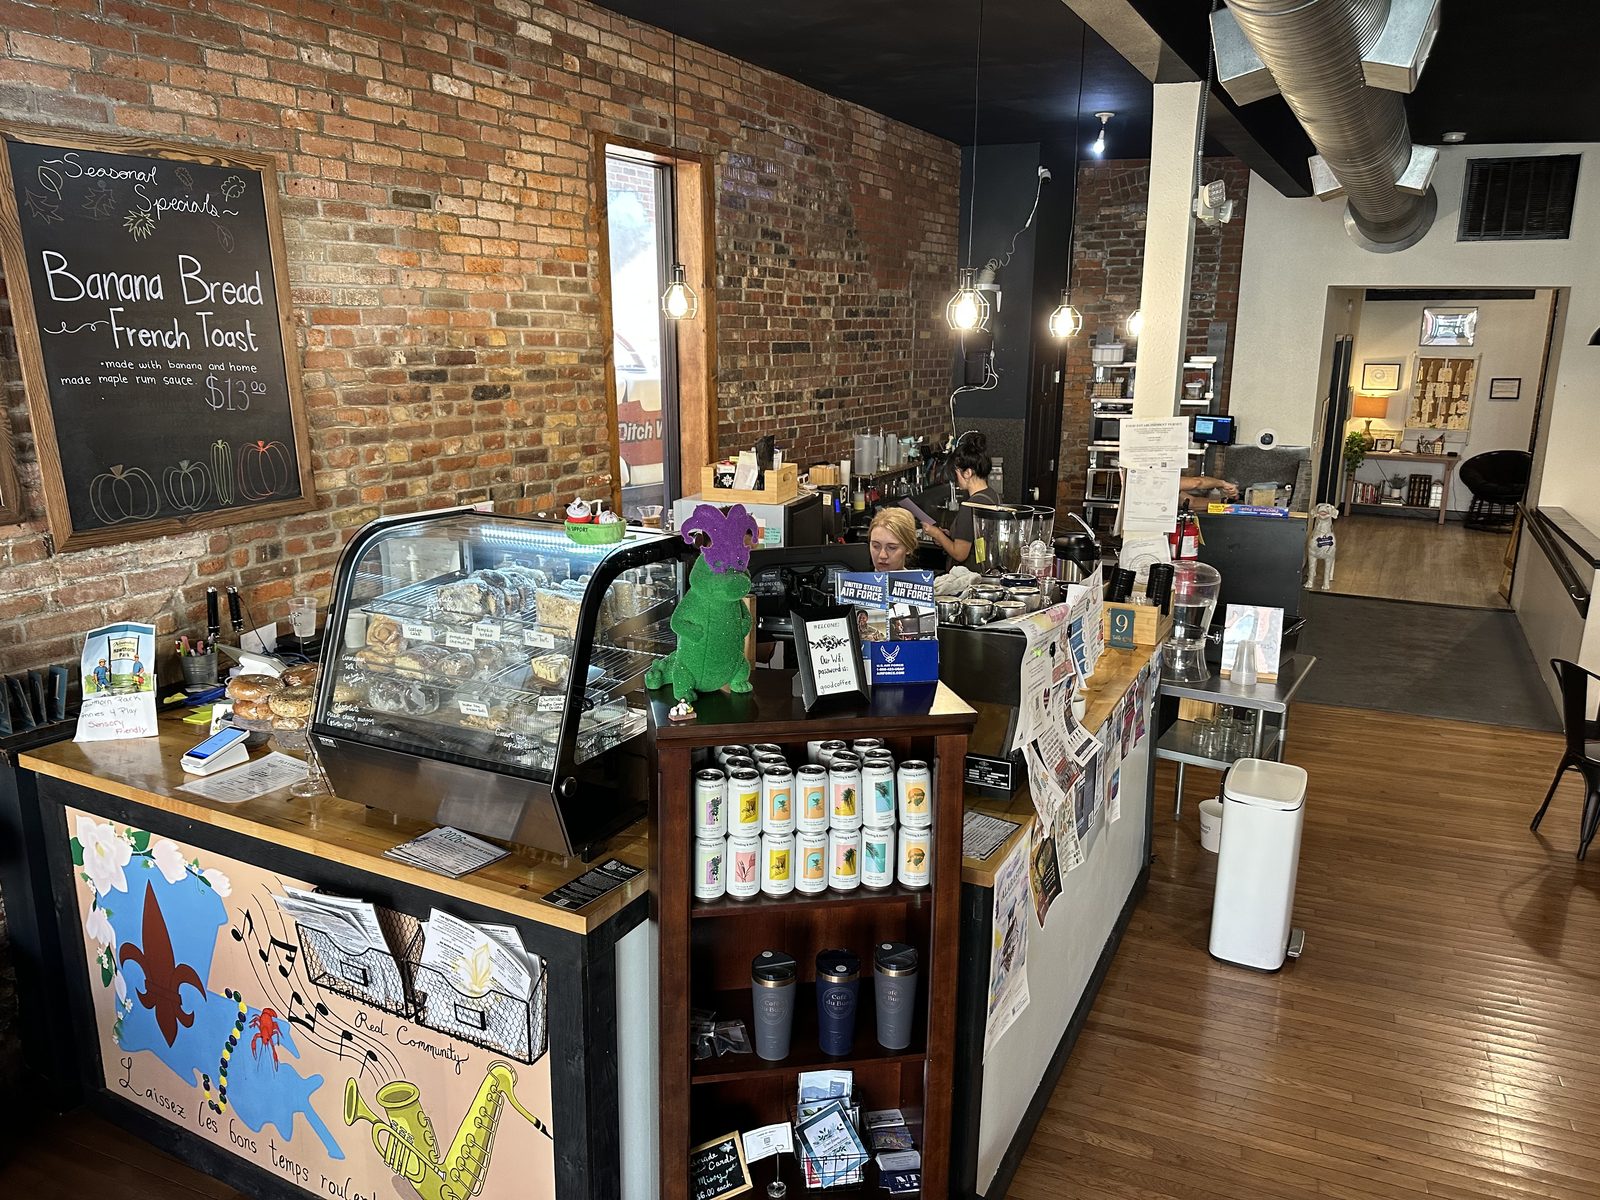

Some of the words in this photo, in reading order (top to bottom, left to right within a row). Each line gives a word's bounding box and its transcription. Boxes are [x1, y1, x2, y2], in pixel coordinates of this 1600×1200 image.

[63, 152, 158, 185] Seasonal
[134, 183, 220, 220] Specials
[42, 250, 164, 302] Banana
[178, 254, 263, 306] Bread
[110, 307, 190, 349] French
[196, 311, 259, 352] Toast
[105, 360, 134, 370] made
[139, 360, 162, 370] with
[168, 360, 202, 371] banana
[209, 362, 225, 372] and
[229, 362, 257, 374] home
[61, 376, 91, 386] made
[98, 374, 128, 387] maple
[135, 375, 156, 385] rum
[618, 420, 654, 441] Ditch
[840, 586, 855, 598] AIR
[856, 588, 883, 602] FORCE
[843, 580, 862, 589] UNITED
[862, 582, 882, 593] STATES
[891, 586, 906, 598] AIR
[906, 588, 933, 601] FORCE
[894, 580, 913, 590] UNITED
[913, 583, 933, 593] STATES
[1115, 614, 1128, 633] 9
[820, 655, 830, 665] Our
[818, 663, 841, 679] password
[820, 679, 851, 694] goodcoffee
[119, 706, 138, 716] Play
[88, 720, 125, 728] Sensory
[115, 727, 147, 735] Friendly
[439, 830, 467, 844] 2026
[355, 1010, 388, 1037] Real
[119, 1057, 187, 1119] Laissez
[199, 1102, 218, 1134] les
[229, 1119, 257, 1155] bons
[270, 1139, 309, 1183] temps
[709, 1153, 738, 1171] Cards
[717, 1180, 734, 1193] each
